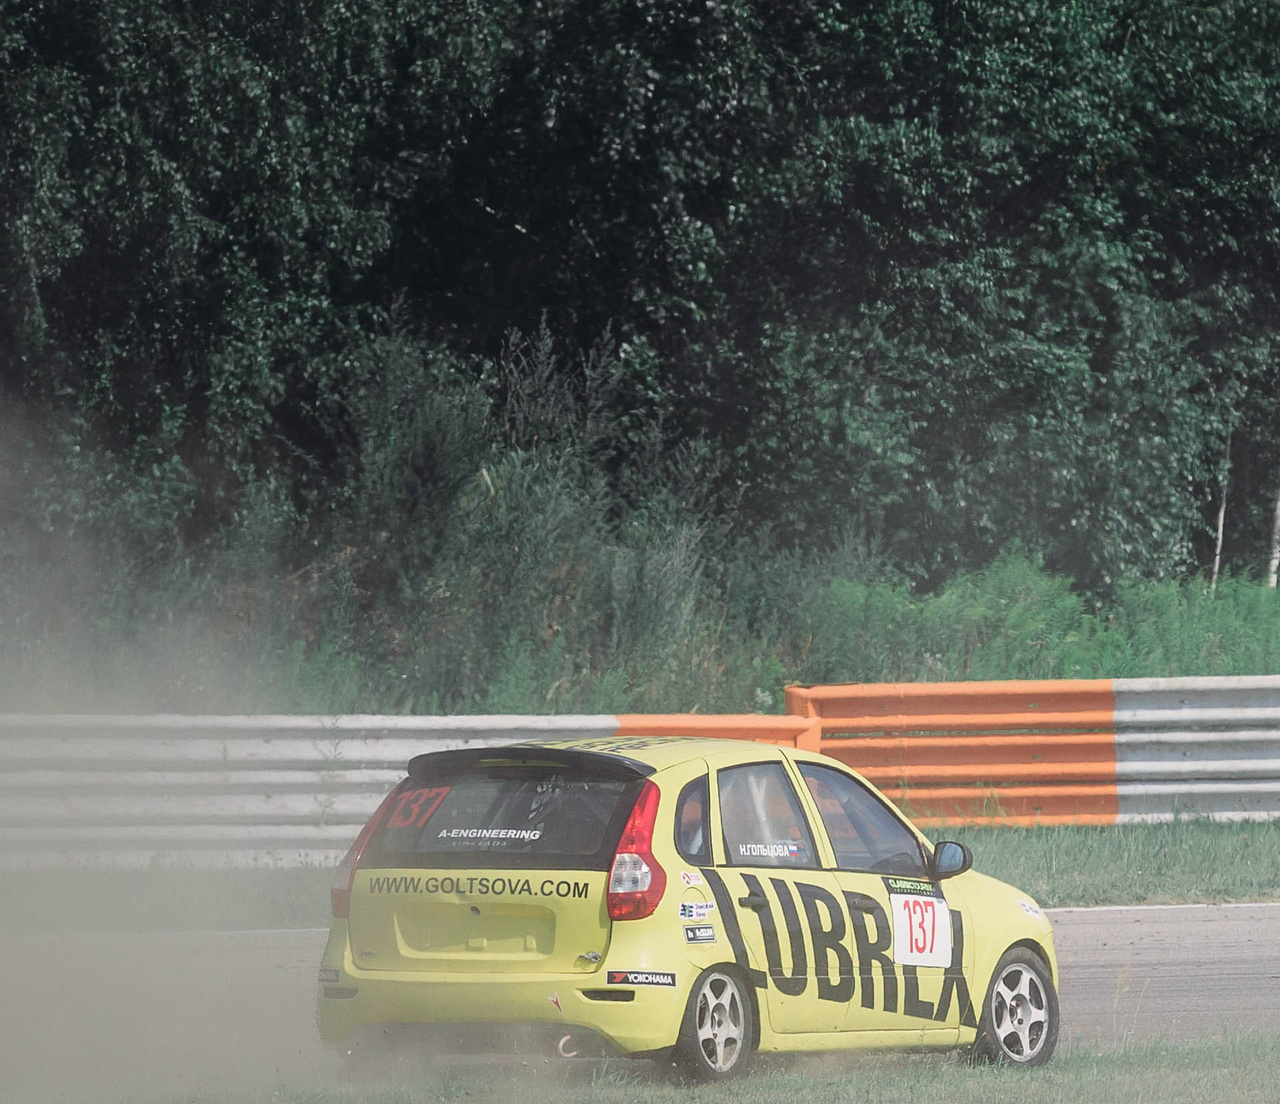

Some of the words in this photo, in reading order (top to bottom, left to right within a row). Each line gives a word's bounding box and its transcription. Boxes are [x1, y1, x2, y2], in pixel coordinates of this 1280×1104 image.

[386, 786, 452, 829] 137
[438, 829, 541, 841] A-ENGINEERING
[369, 877, 589, 898] WWW.GOLTSOVA.COM
[903, 900, 936, 954] 137
[627, 973, 673, 984] YOKOHAMA
